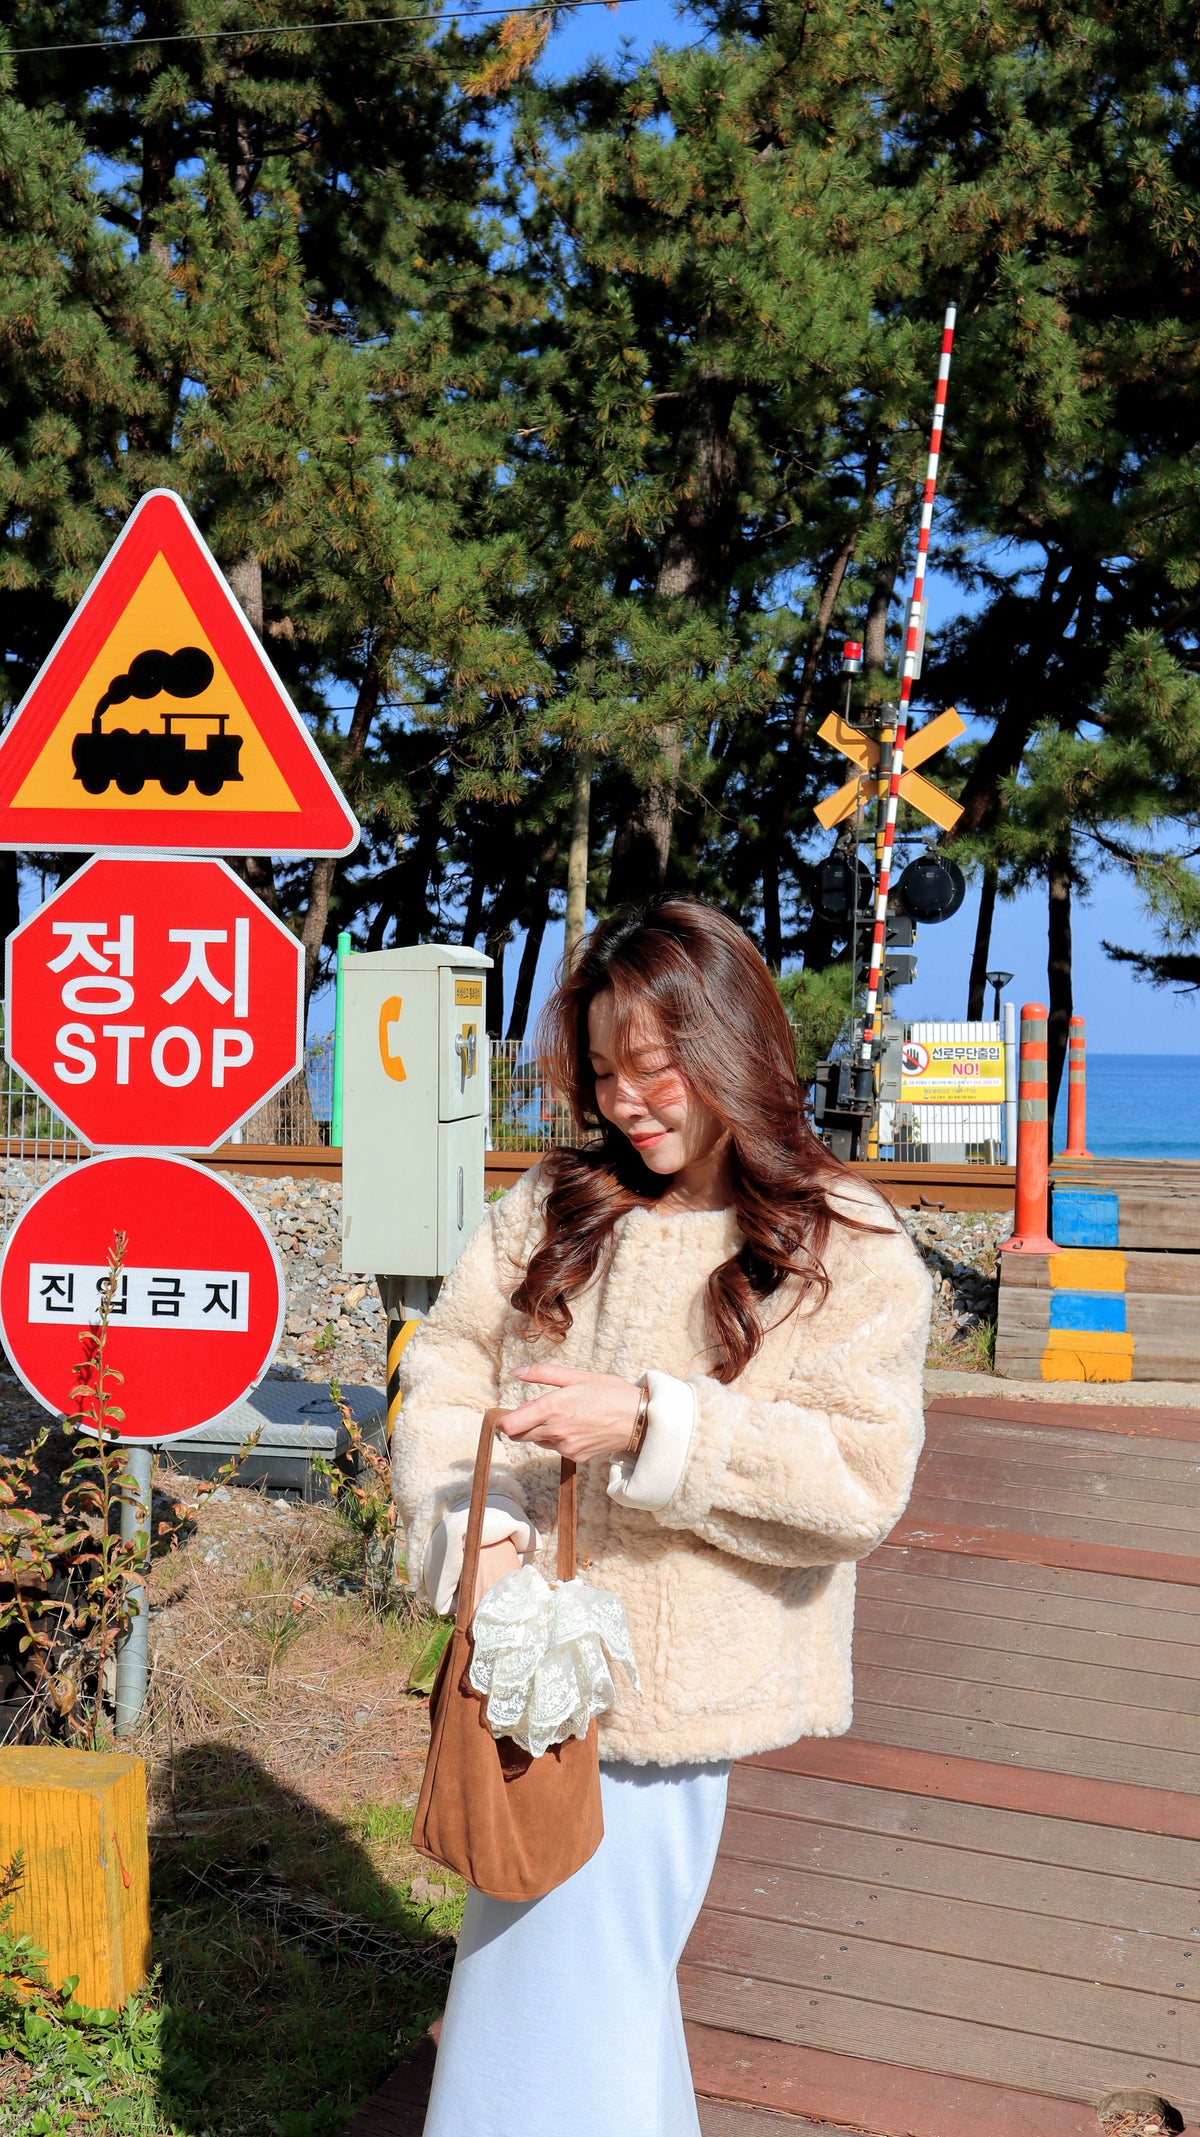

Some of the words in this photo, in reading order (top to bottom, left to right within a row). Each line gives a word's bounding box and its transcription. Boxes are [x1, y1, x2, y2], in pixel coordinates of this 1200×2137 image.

[46, 915, 250, 1018] 정지
[53, 1022, 254, 1088] STOP
[932, 1047, 1000, 1060] 선로무단출입
[952, 1063, 979, 1076] NO!
[39, 1272, 239, 1320] 진입금지
